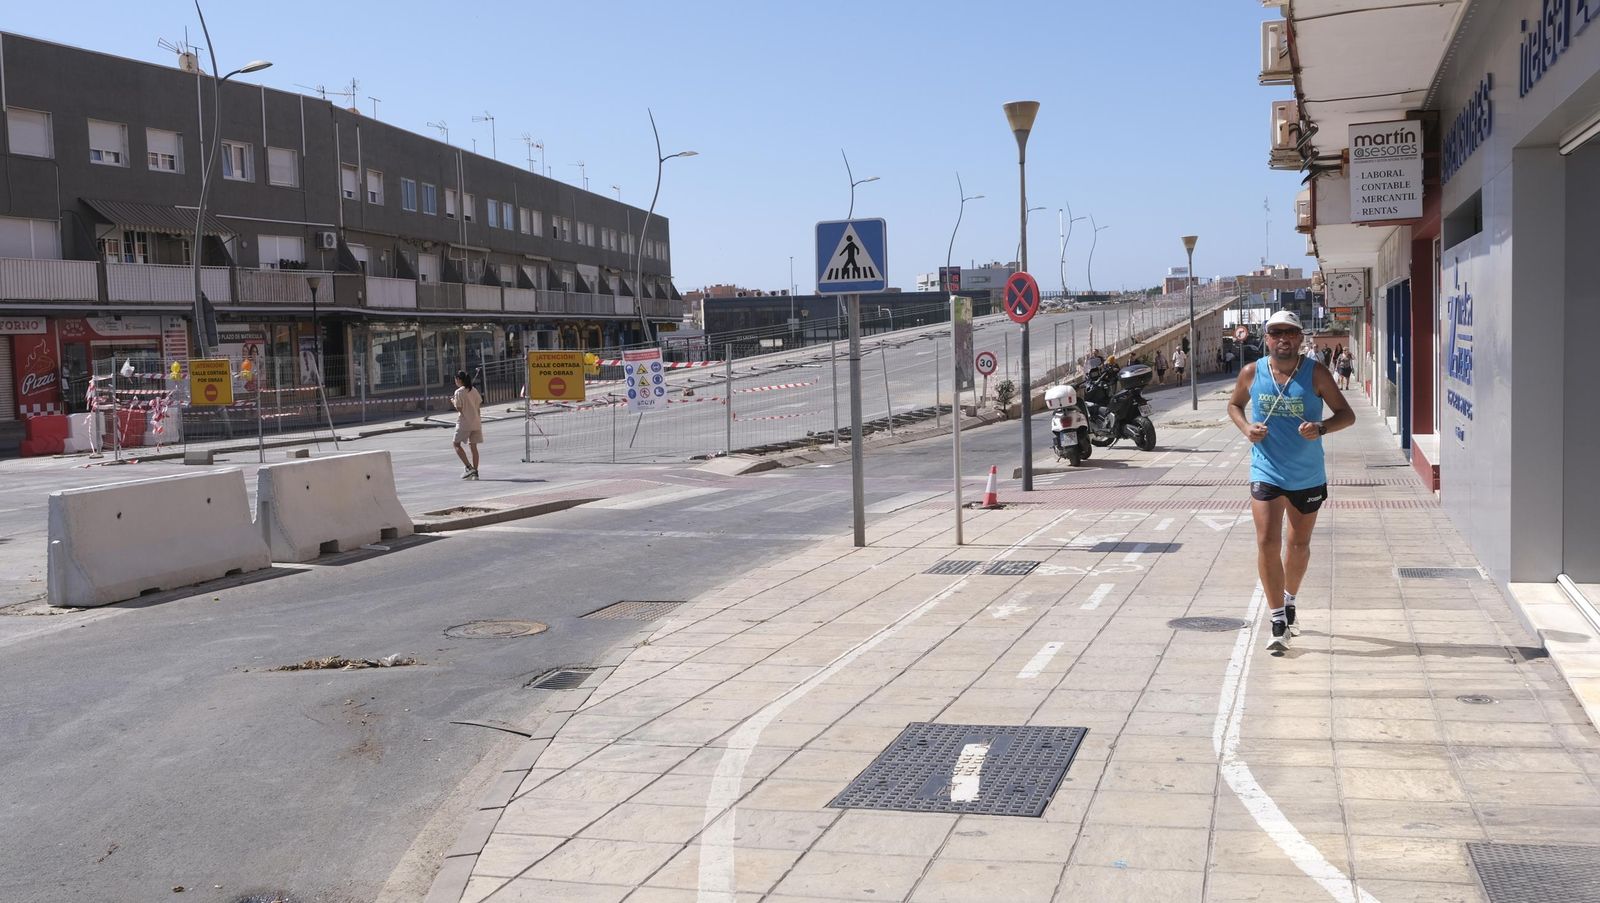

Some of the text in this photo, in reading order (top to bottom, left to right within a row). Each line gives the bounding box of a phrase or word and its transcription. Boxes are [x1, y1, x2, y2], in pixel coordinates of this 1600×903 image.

[1354, 127, 1416, 147] martín
[1361, 169, 1405, 180] LABORAL
[1361, 181, 1411, 192] CONTABLE
[1362, 193, 1417, 204] MERCANTIL
[1362, 206, 1398, 216] RENTAS
[979, 358, 993, 368] 30
[21, 373, 56, 395] Pizza
